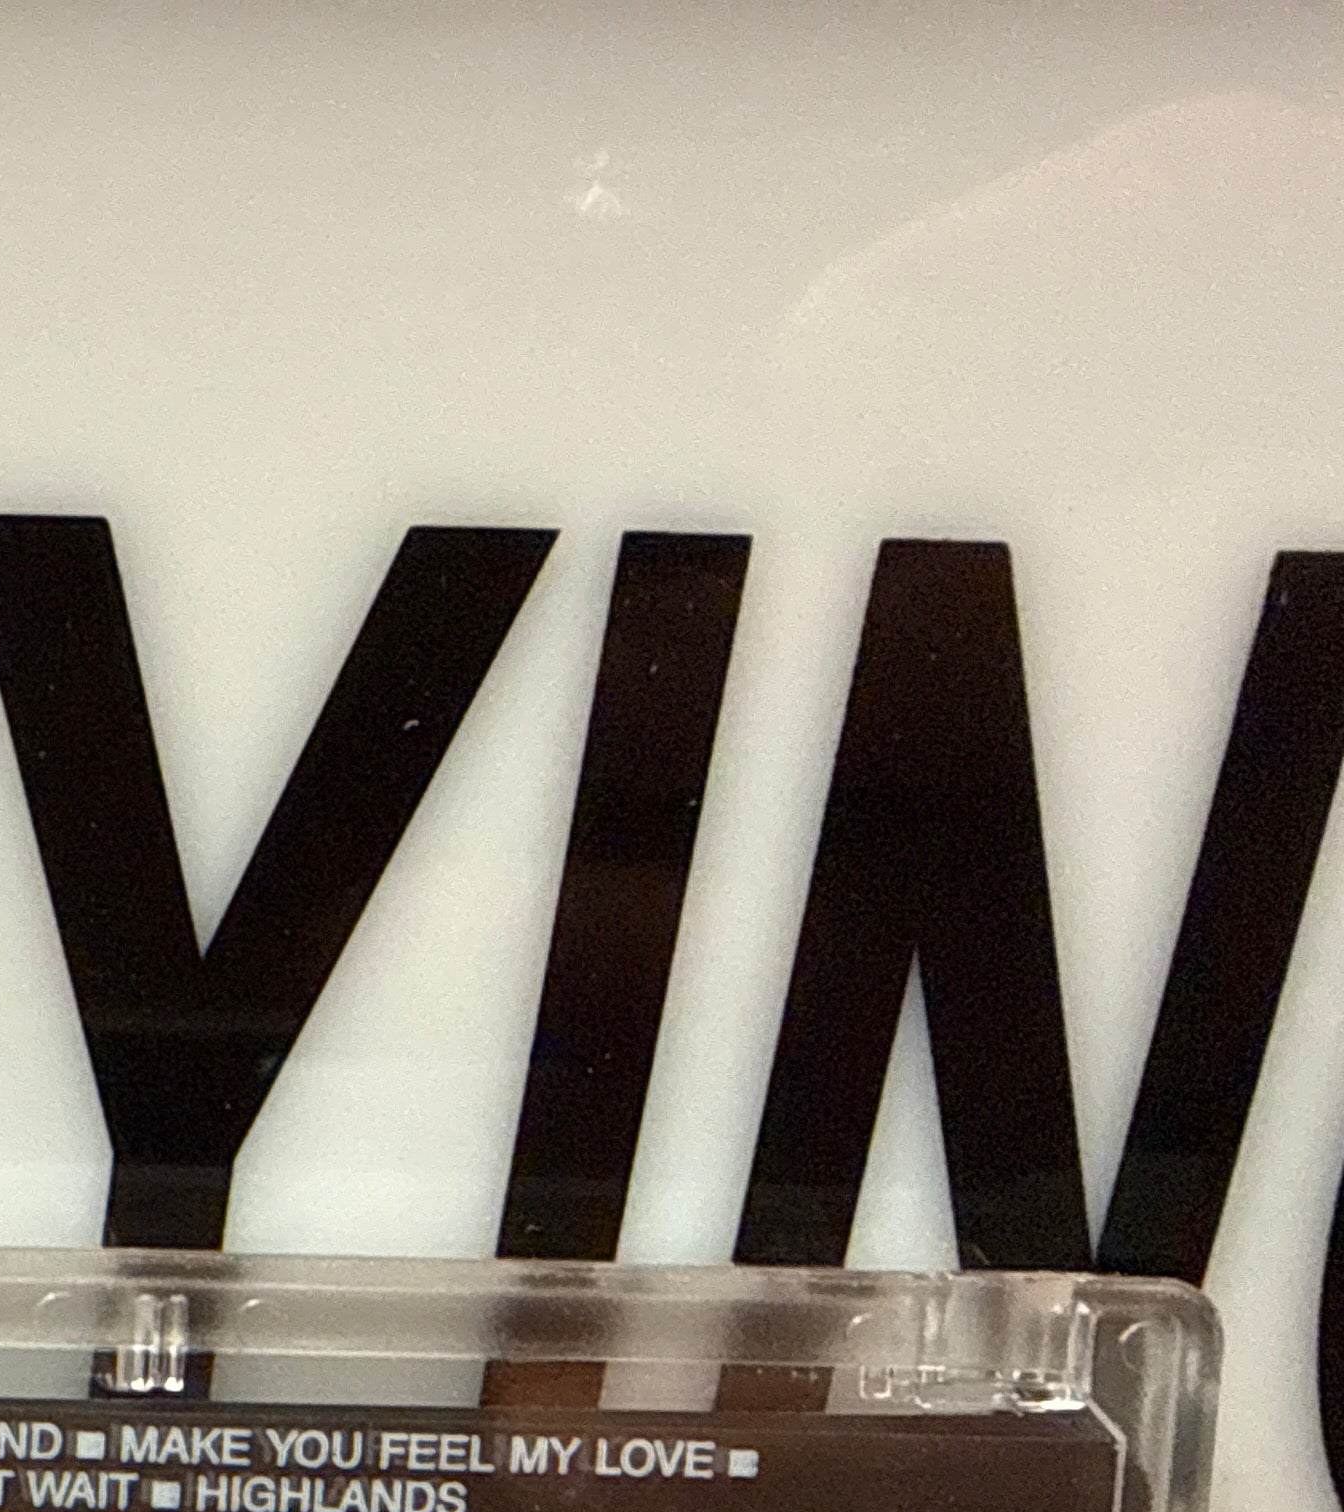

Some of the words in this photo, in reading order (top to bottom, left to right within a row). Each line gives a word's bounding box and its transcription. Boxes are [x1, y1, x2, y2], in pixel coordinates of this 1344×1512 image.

[118, 1425, 253, 1465] MAKE
[265, 1429, 364, 1470] YOU
[379, 1431, 495, 1474] FEEL
[509, 1434, 581, 1475] MY
[593, 1437, 716, 1479] LOVE
[27, 1470, 140, 1510] WAIT
